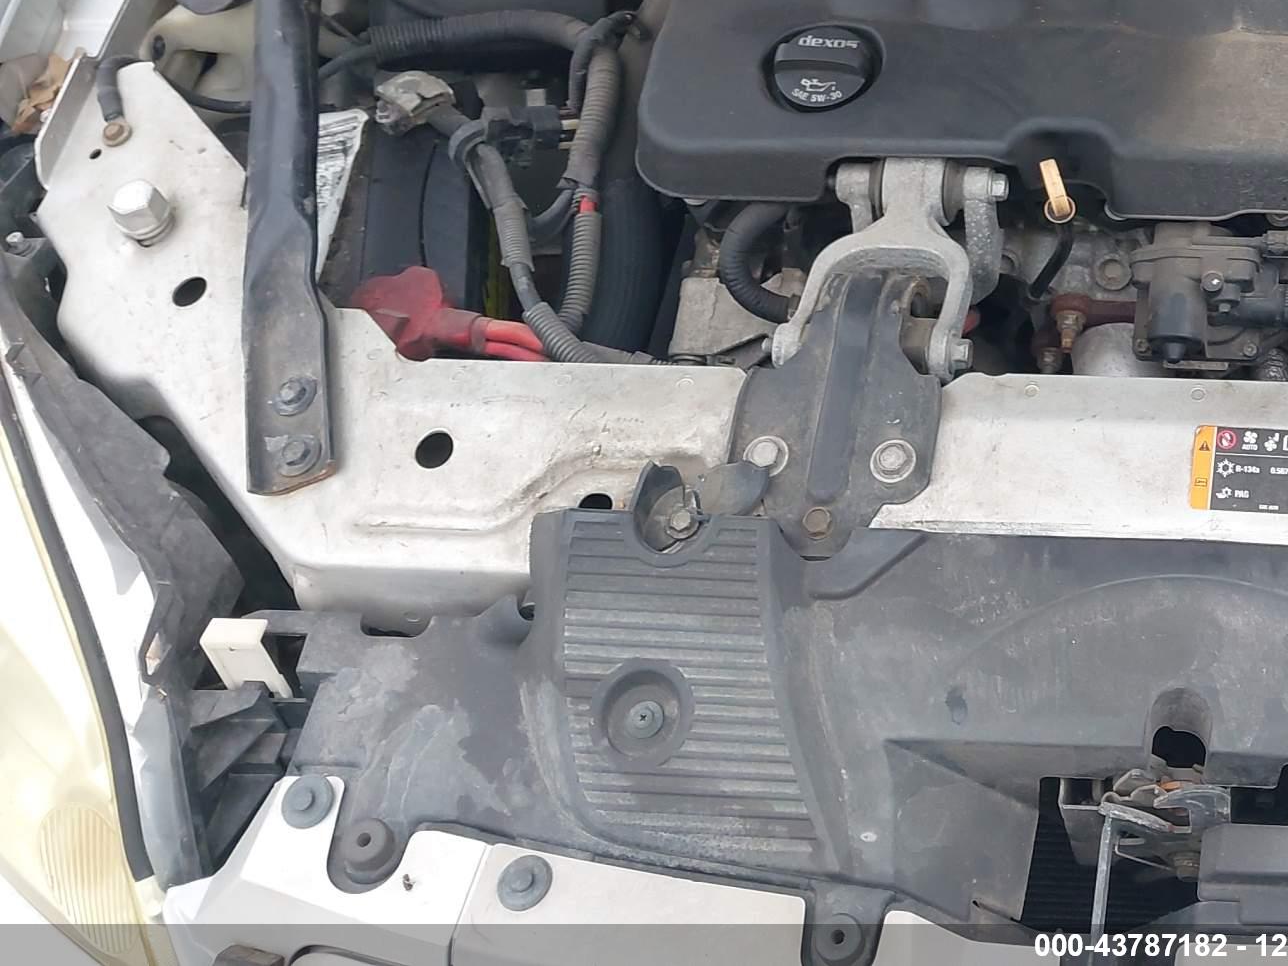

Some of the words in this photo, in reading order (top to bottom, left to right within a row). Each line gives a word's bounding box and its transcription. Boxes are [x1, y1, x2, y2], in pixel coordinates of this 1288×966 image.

[798, 35, 861, 49] dexos
[791, 88, 810, 101] SAE
[810, 90, 843, 103] 5W-30
